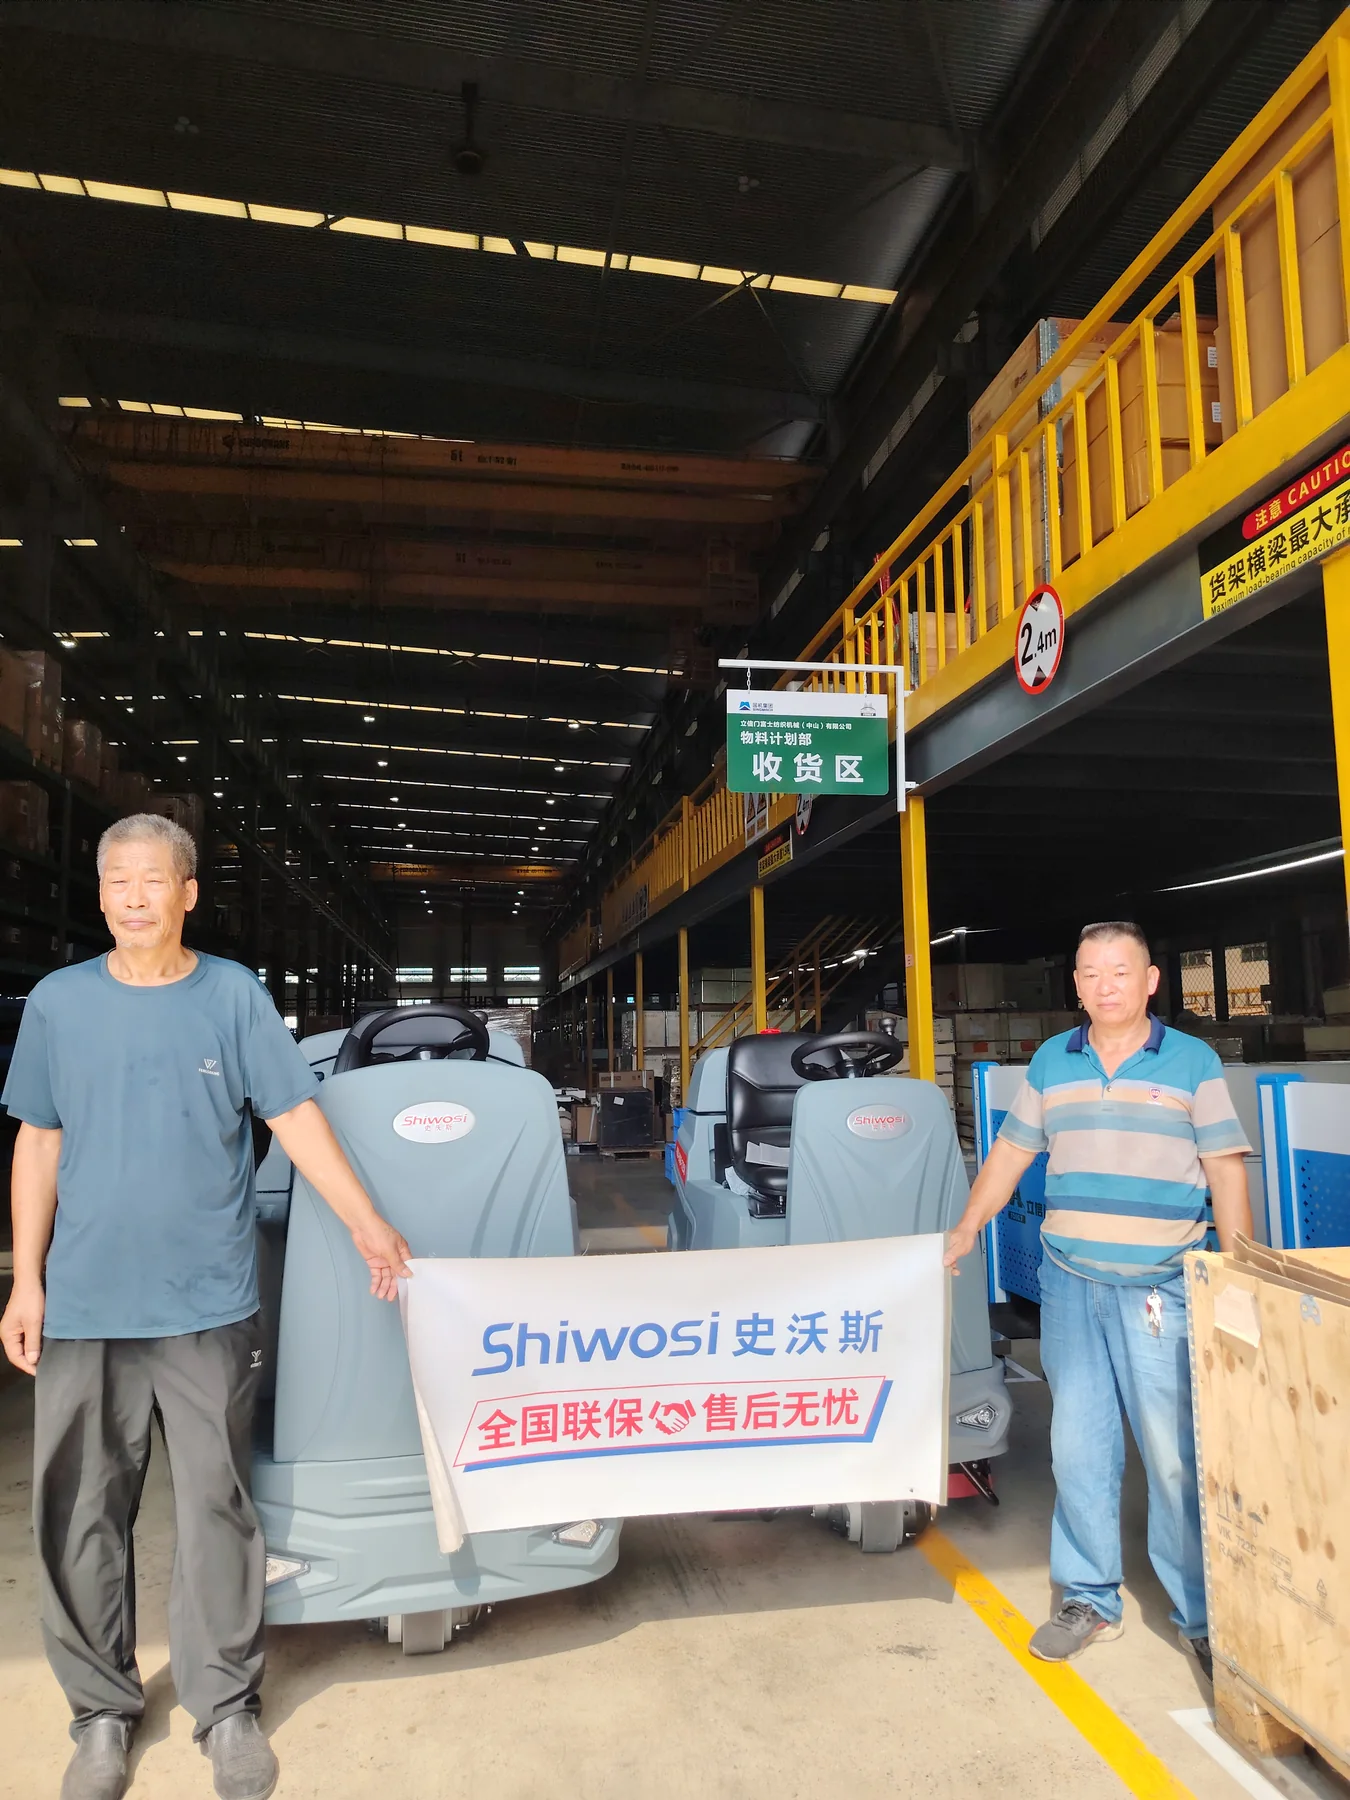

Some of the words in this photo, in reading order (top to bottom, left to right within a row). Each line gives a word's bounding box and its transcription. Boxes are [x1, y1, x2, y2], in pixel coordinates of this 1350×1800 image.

[1255, 498, 1282, 531] 注意
[1211, 590, 1244, 615] Maximum
[1246, 559, 1296, 596] load-bearing
[1298, 536, 1334, 565] capacity
[1336, 529, 1349, 541] of
[1020, 622, 1057, 666] 2.4m
[740, 731, 812, 746] 物料计划部
[752, 751, 864, 783] 收货区
[401, 1113, 468, 1127] Shiwosi
[853, 1115, 906, 1125] Shiwosi
[470, 1311, 720, 1377] Shiwosi
[732, 1309, 886, 1358] 史沃斯
[477, 1397, 643, 1451] 全国联保
[701, 1388, 860, 1433] 售后无忧
